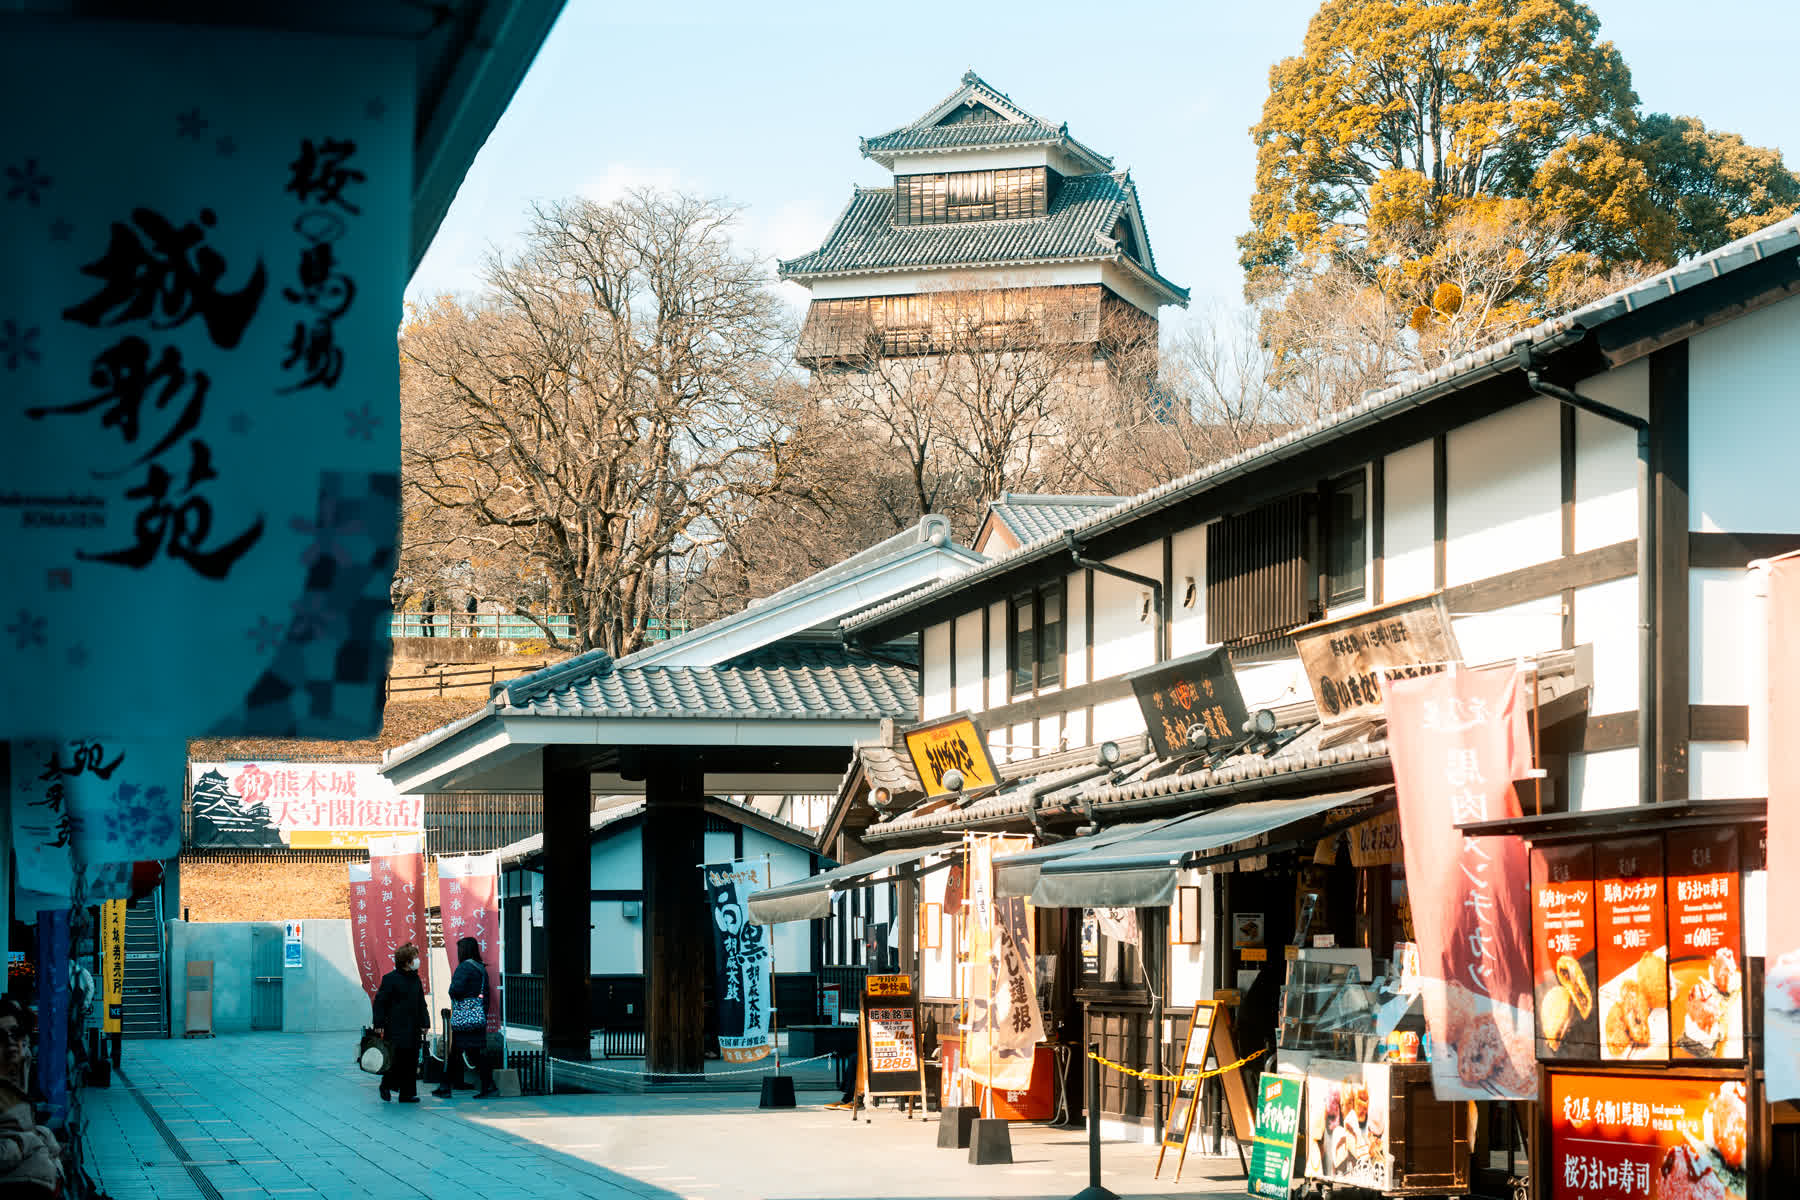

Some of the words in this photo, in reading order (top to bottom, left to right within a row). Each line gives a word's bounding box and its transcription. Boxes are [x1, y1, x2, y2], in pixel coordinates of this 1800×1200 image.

[24, 207, 268, 581] 城彩苑
[271, 769, 358, 798] 熊本城
[874, 1057, 912, 1070] 1288
[1563, 1153, 1650, 1196] 桜うまトロ寿司
